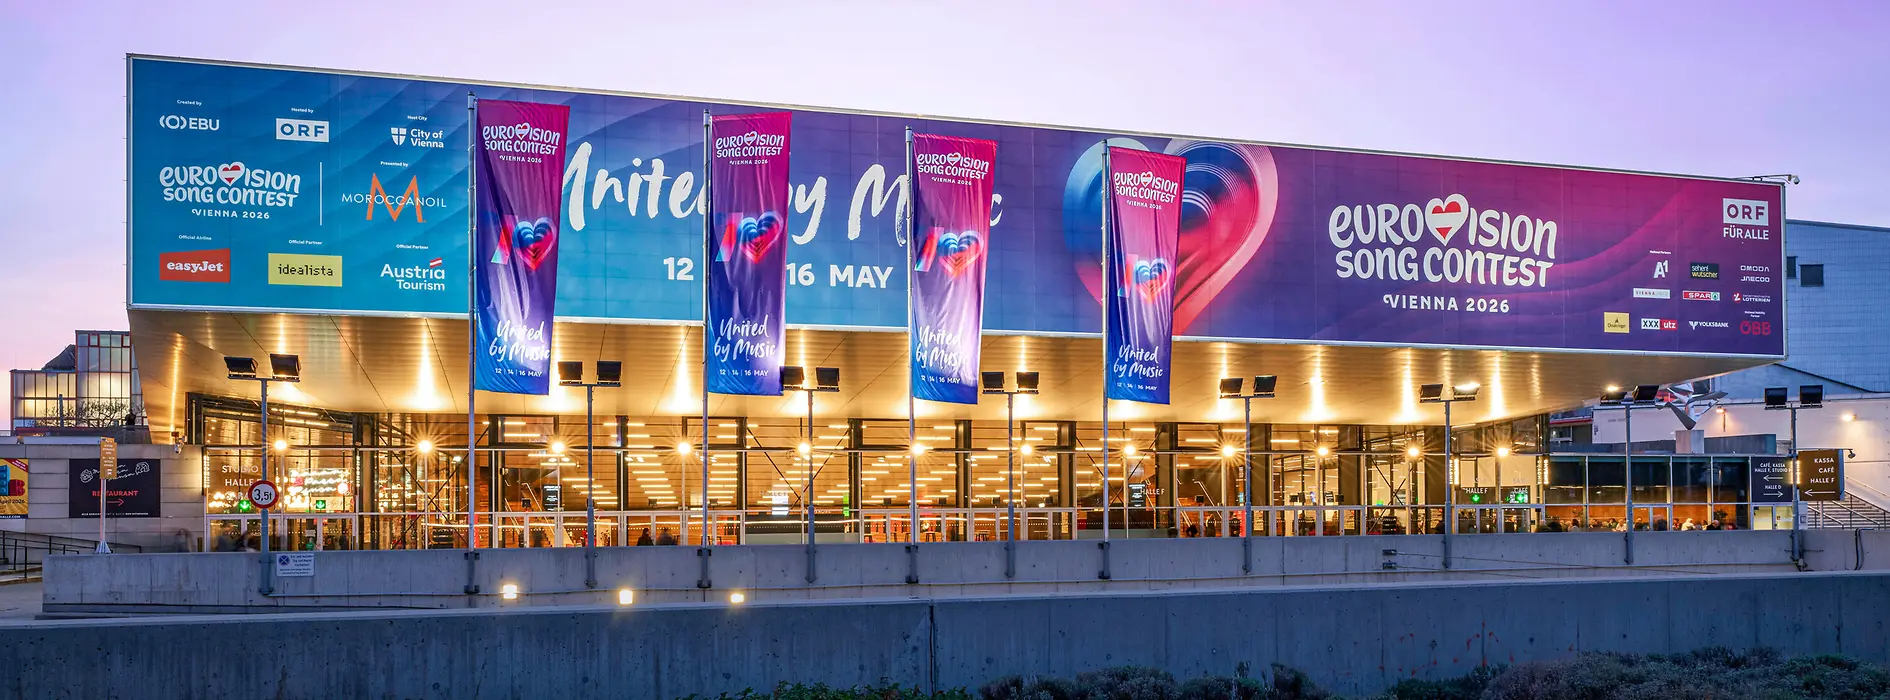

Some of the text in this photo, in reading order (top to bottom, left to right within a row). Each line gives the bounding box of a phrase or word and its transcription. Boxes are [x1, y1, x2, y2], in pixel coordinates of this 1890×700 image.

[189, 118, 220, 131] EBU
[280, 123, 325, 138] ORF
[410, 128, 443, 140] City of
[410, 138, 444, 148] Vienna
[485, 140, 557, 155] SONG CONTEST
[717, 146, 782, 157] SONG CONTEST
[918, 165, 987, 180] SONG CONTEST
[163, 187, 298, 207] SONG CONTEST
[341, 194, 447, 207] MOROCCANOIL
[562, 141, 711, 232] nite
[788, 176, 827, 245] y
[1116, 185, 1176, 203] SONG CONTEST
[1126, 200, 1148, 208] VIENNA
[192, 209, 270, 219] VIENNA 2026
[1727, 204, 1764, 220] ORF
[1723, 225, 1769, 240] FÜR ALLE
[167, 261, 223, 273] easyJet
[278, 264, 333, 276] idealista
[380, 264, 445, 280] Austria
[663, 257, 893, 288] 12 16 MAY
[1335, 247, 1553, 287] SONG CONTEST
[1654, 260, 1668, 278] A1
[396, 279, 445, 291] Tourism
[1384, 294, 1509, 313] VIENNA 2026
[720, 314, 770, 341] United
[489, 337, 506, 362] by
[714, 337, 776, 362] by Music
[916, 343, 927, 368] by
[1119, 344, 1158, 363] United
[1114, 358, 1163, 380] by Music
[222, 465, 258, 473] STUDIO
[254, 488, 272, 501] 3,5t
